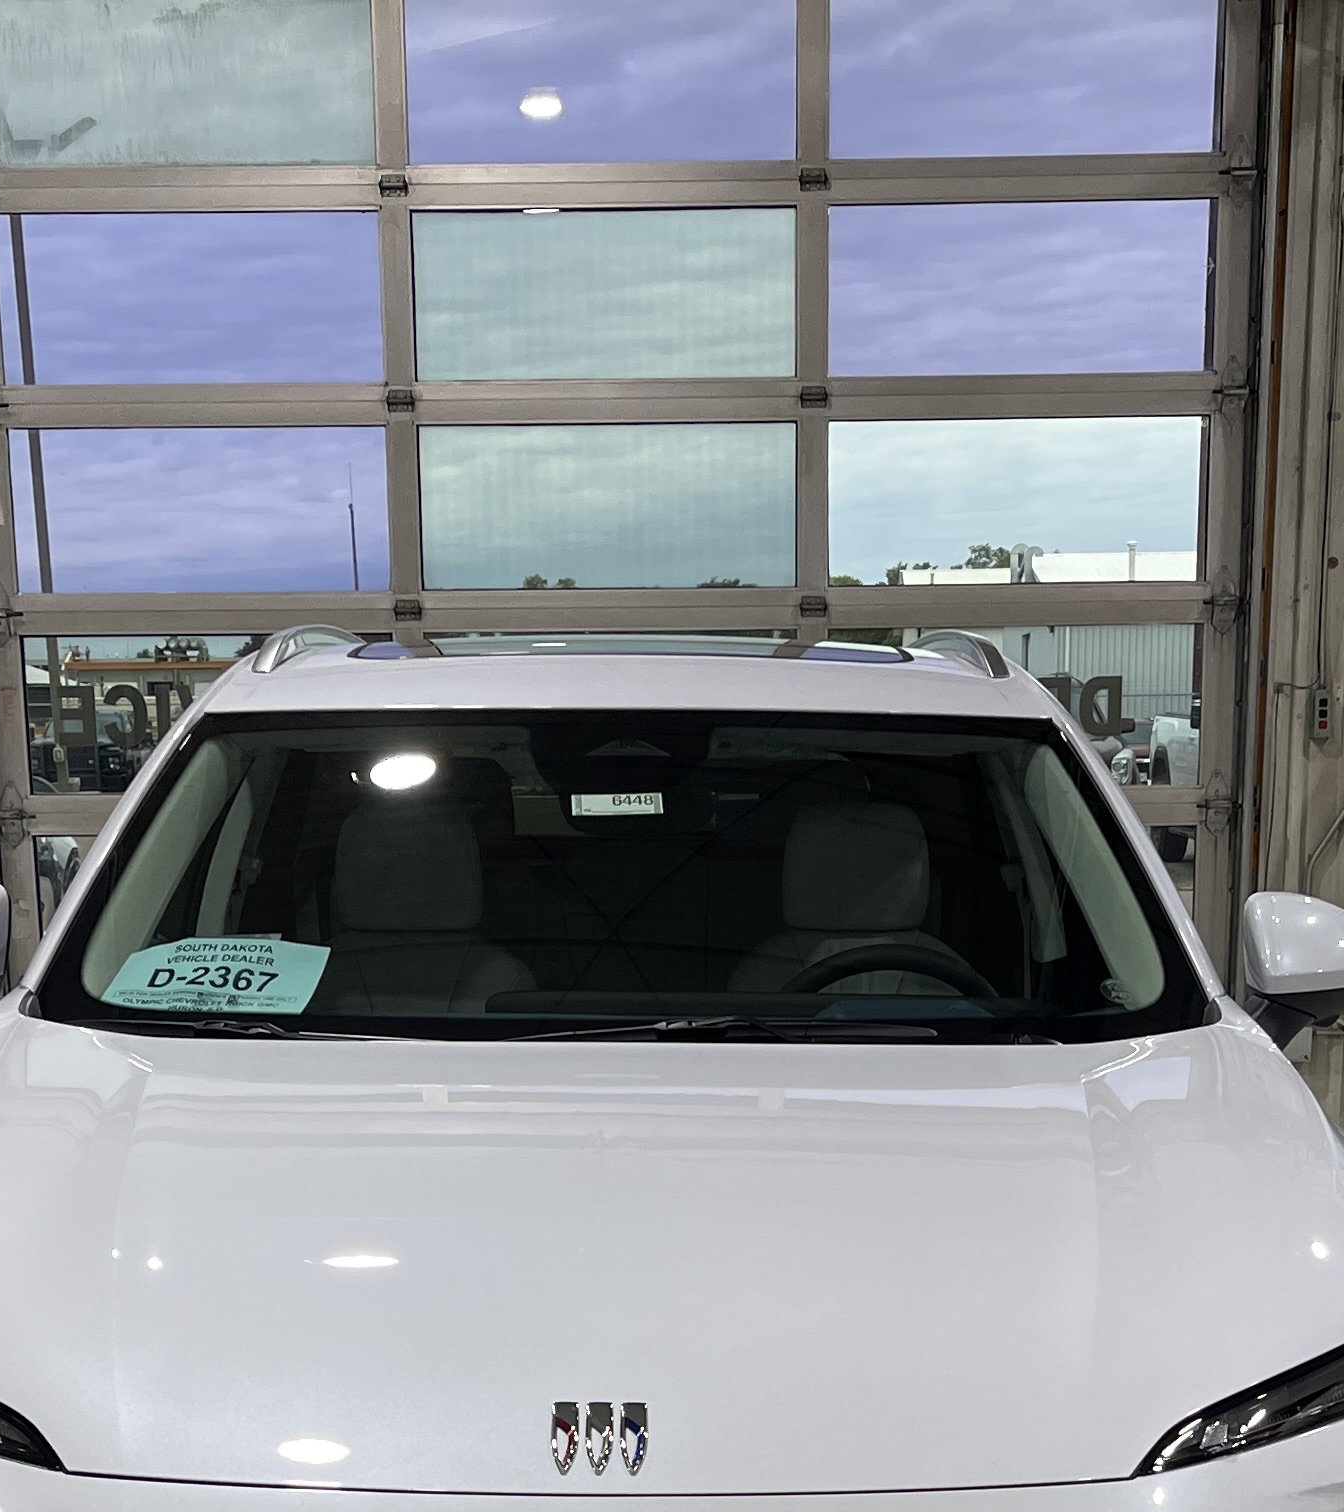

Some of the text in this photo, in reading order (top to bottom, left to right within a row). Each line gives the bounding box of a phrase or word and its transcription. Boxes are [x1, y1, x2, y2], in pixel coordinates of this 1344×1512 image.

[174, 943, 274, 955] SOUTH DAKOTA
[167, 954, 275, 967] VEHICLE DEALER
[147, 965, 280, 993] D-2367
